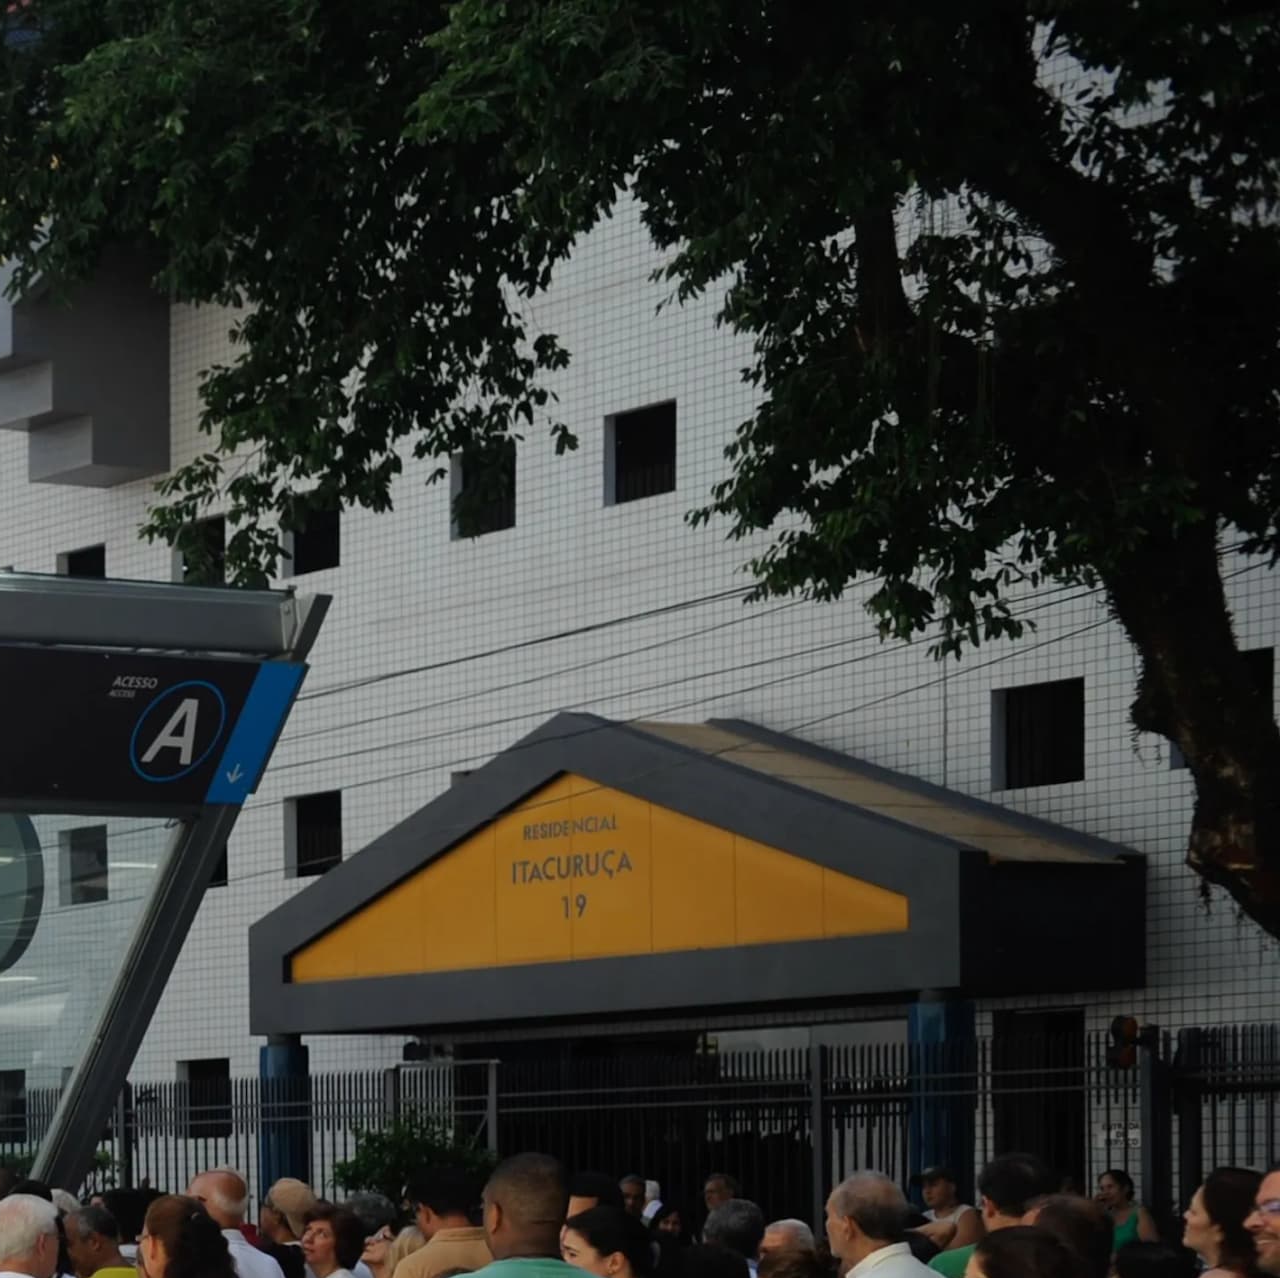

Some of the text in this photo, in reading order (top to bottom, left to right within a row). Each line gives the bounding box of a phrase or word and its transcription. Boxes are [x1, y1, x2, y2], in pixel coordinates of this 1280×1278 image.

[112, 676, 158, 689] ACESSO
[141, 698, 199, 765] A
[523, 814, 617, 840] RESIDENCIAL
[512, 850, 633, 885] ITACURUÇA
[562, 893, 587, 920] 19
